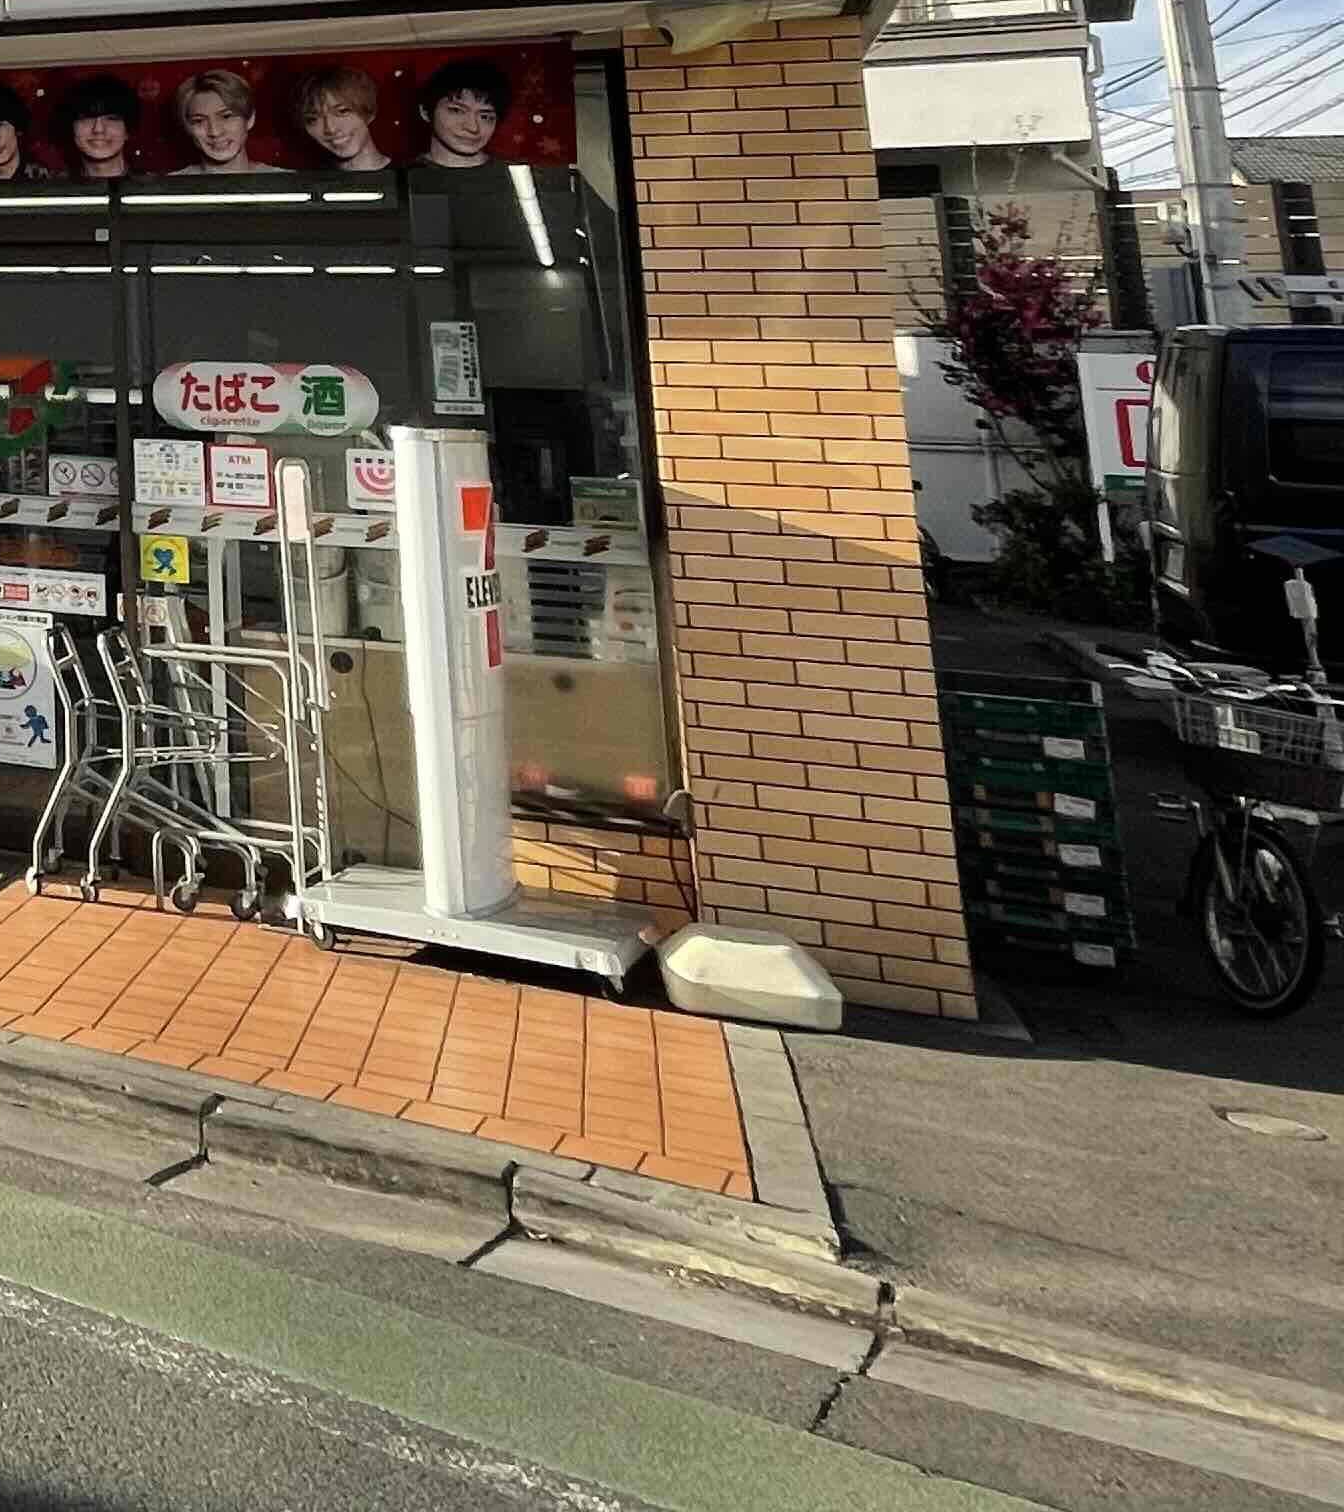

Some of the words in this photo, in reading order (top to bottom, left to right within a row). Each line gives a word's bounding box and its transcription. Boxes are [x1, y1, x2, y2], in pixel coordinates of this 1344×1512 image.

[180, 371, 280, 414] たばこ
[300, 375, 346, 417] 酒
[227, 455, 252, 465] ATM
